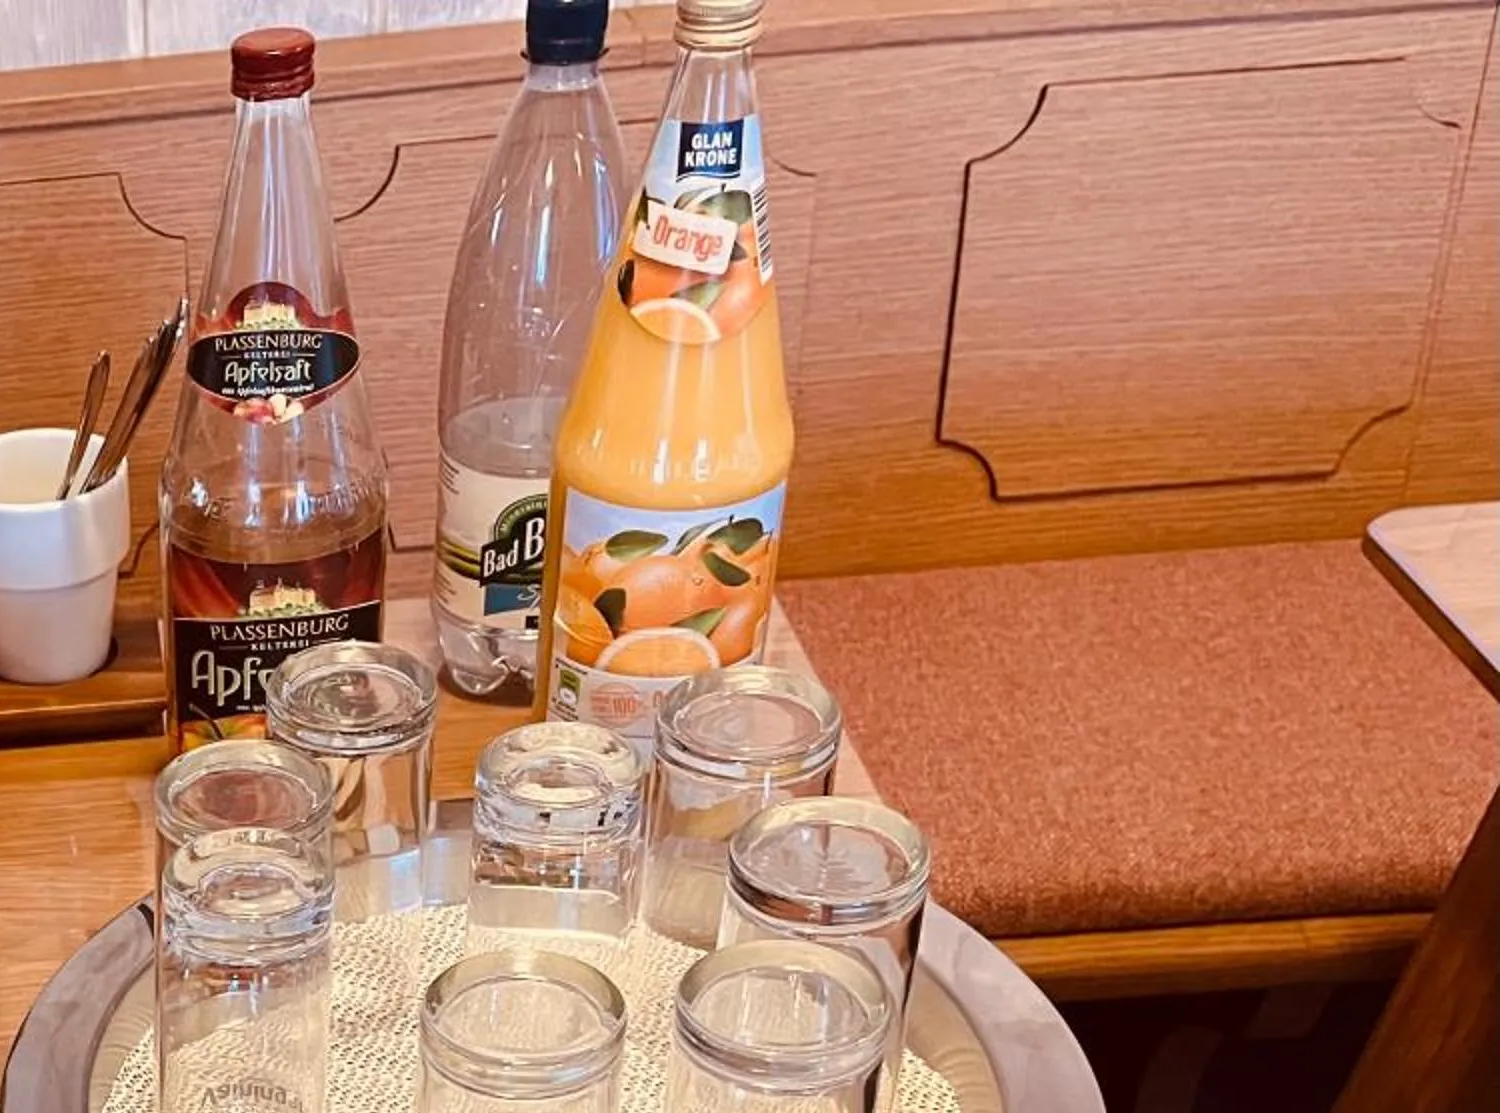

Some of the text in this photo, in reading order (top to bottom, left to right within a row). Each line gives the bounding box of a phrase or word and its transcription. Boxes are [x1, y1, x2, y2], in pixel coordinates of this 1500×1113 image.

[691, 131, 733, 149] GLAN
[685, 148, 737, 168] KRONE
[653, 215, 724, 261] Orange
[214, 333, 323, 352] PLASSENBURG
[224, 359, 312, 386] Apfelsaft
[483, 517, 545, 578] Bad B
[210, 613, 350, 642] PLASSENBURG
